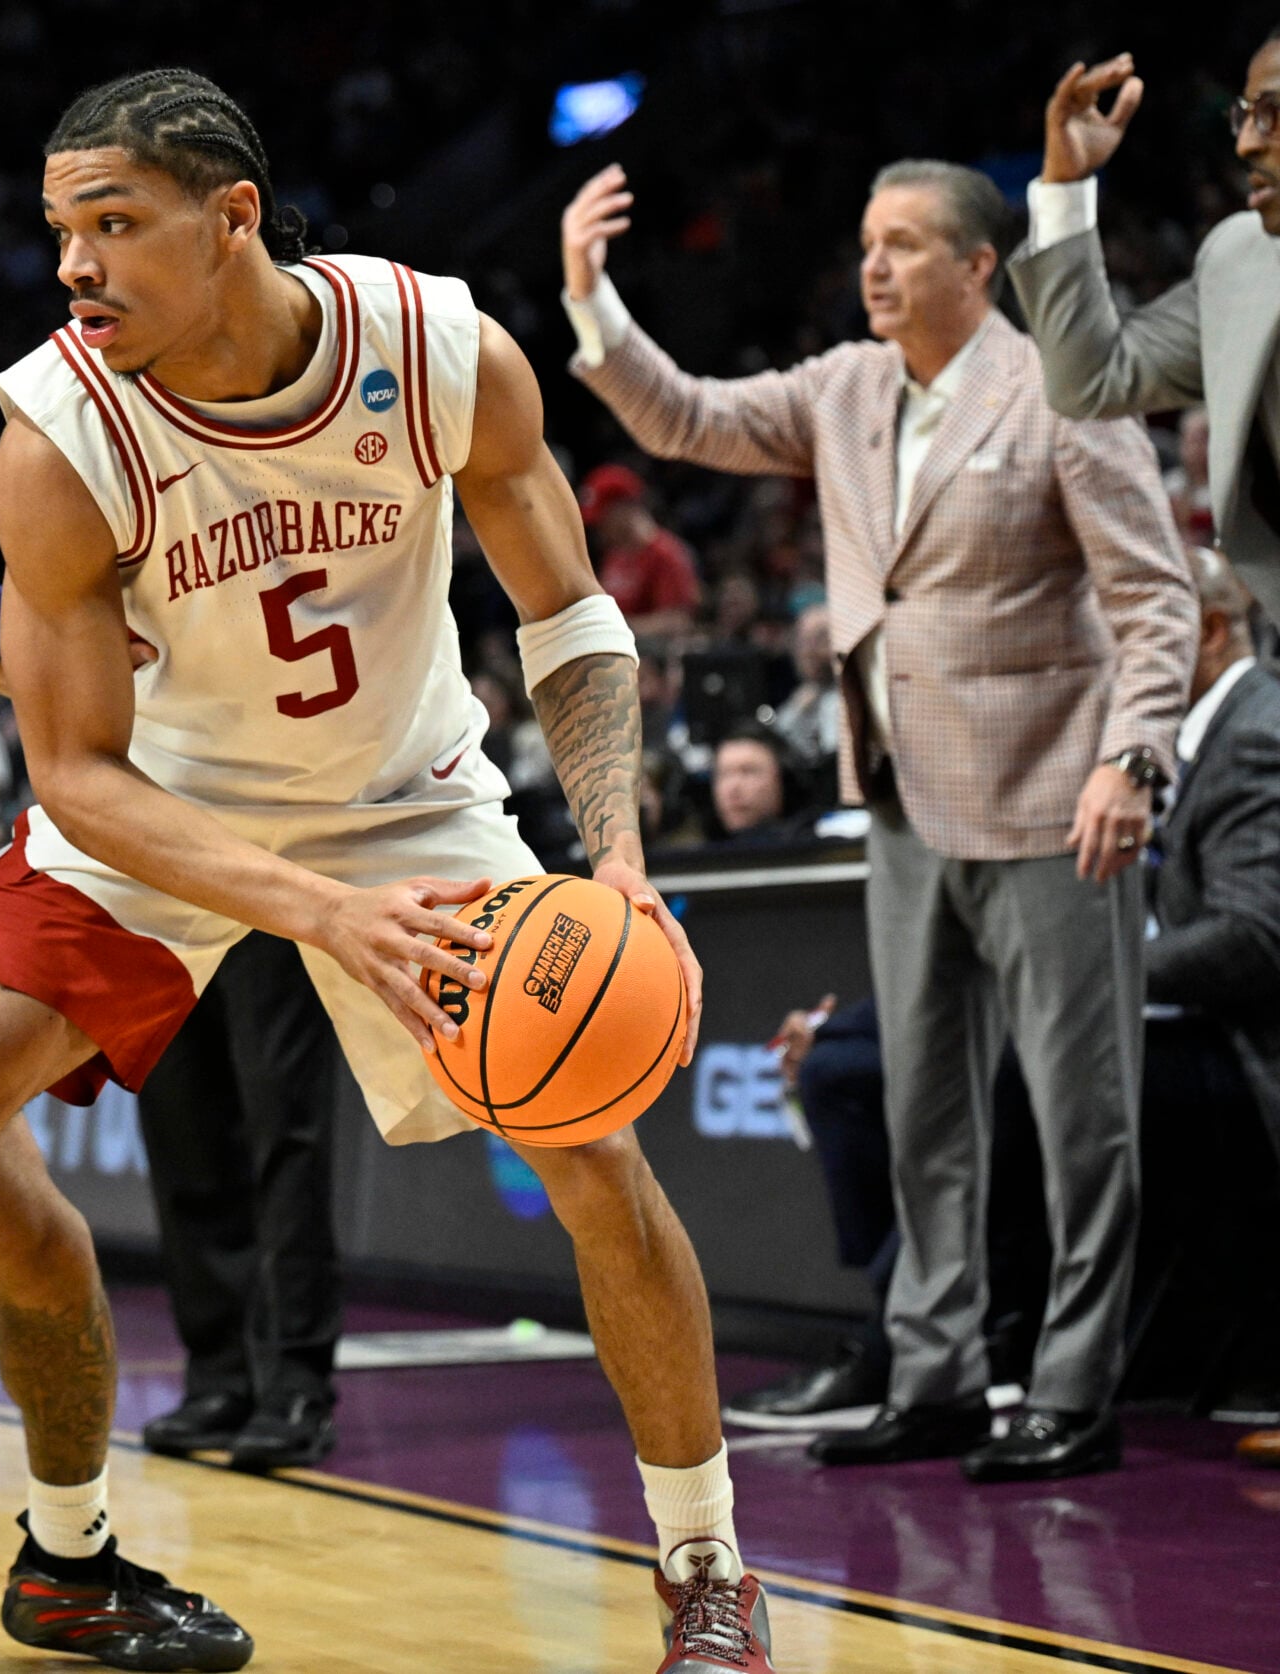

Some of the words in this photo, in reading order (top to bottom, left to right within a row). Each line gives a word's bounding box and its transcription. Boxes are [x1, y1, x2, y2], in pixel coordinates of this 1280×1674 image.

[366, 388, 396, 403] NCAA
[357, 435, 385, 462] SEC
[165, 500, 402, 602] RAZORBACKS
[258, 568, 360, 719] 5
[531, 933, 564, 983] MARCH
[549, 922, 587, 983] MADNESS
